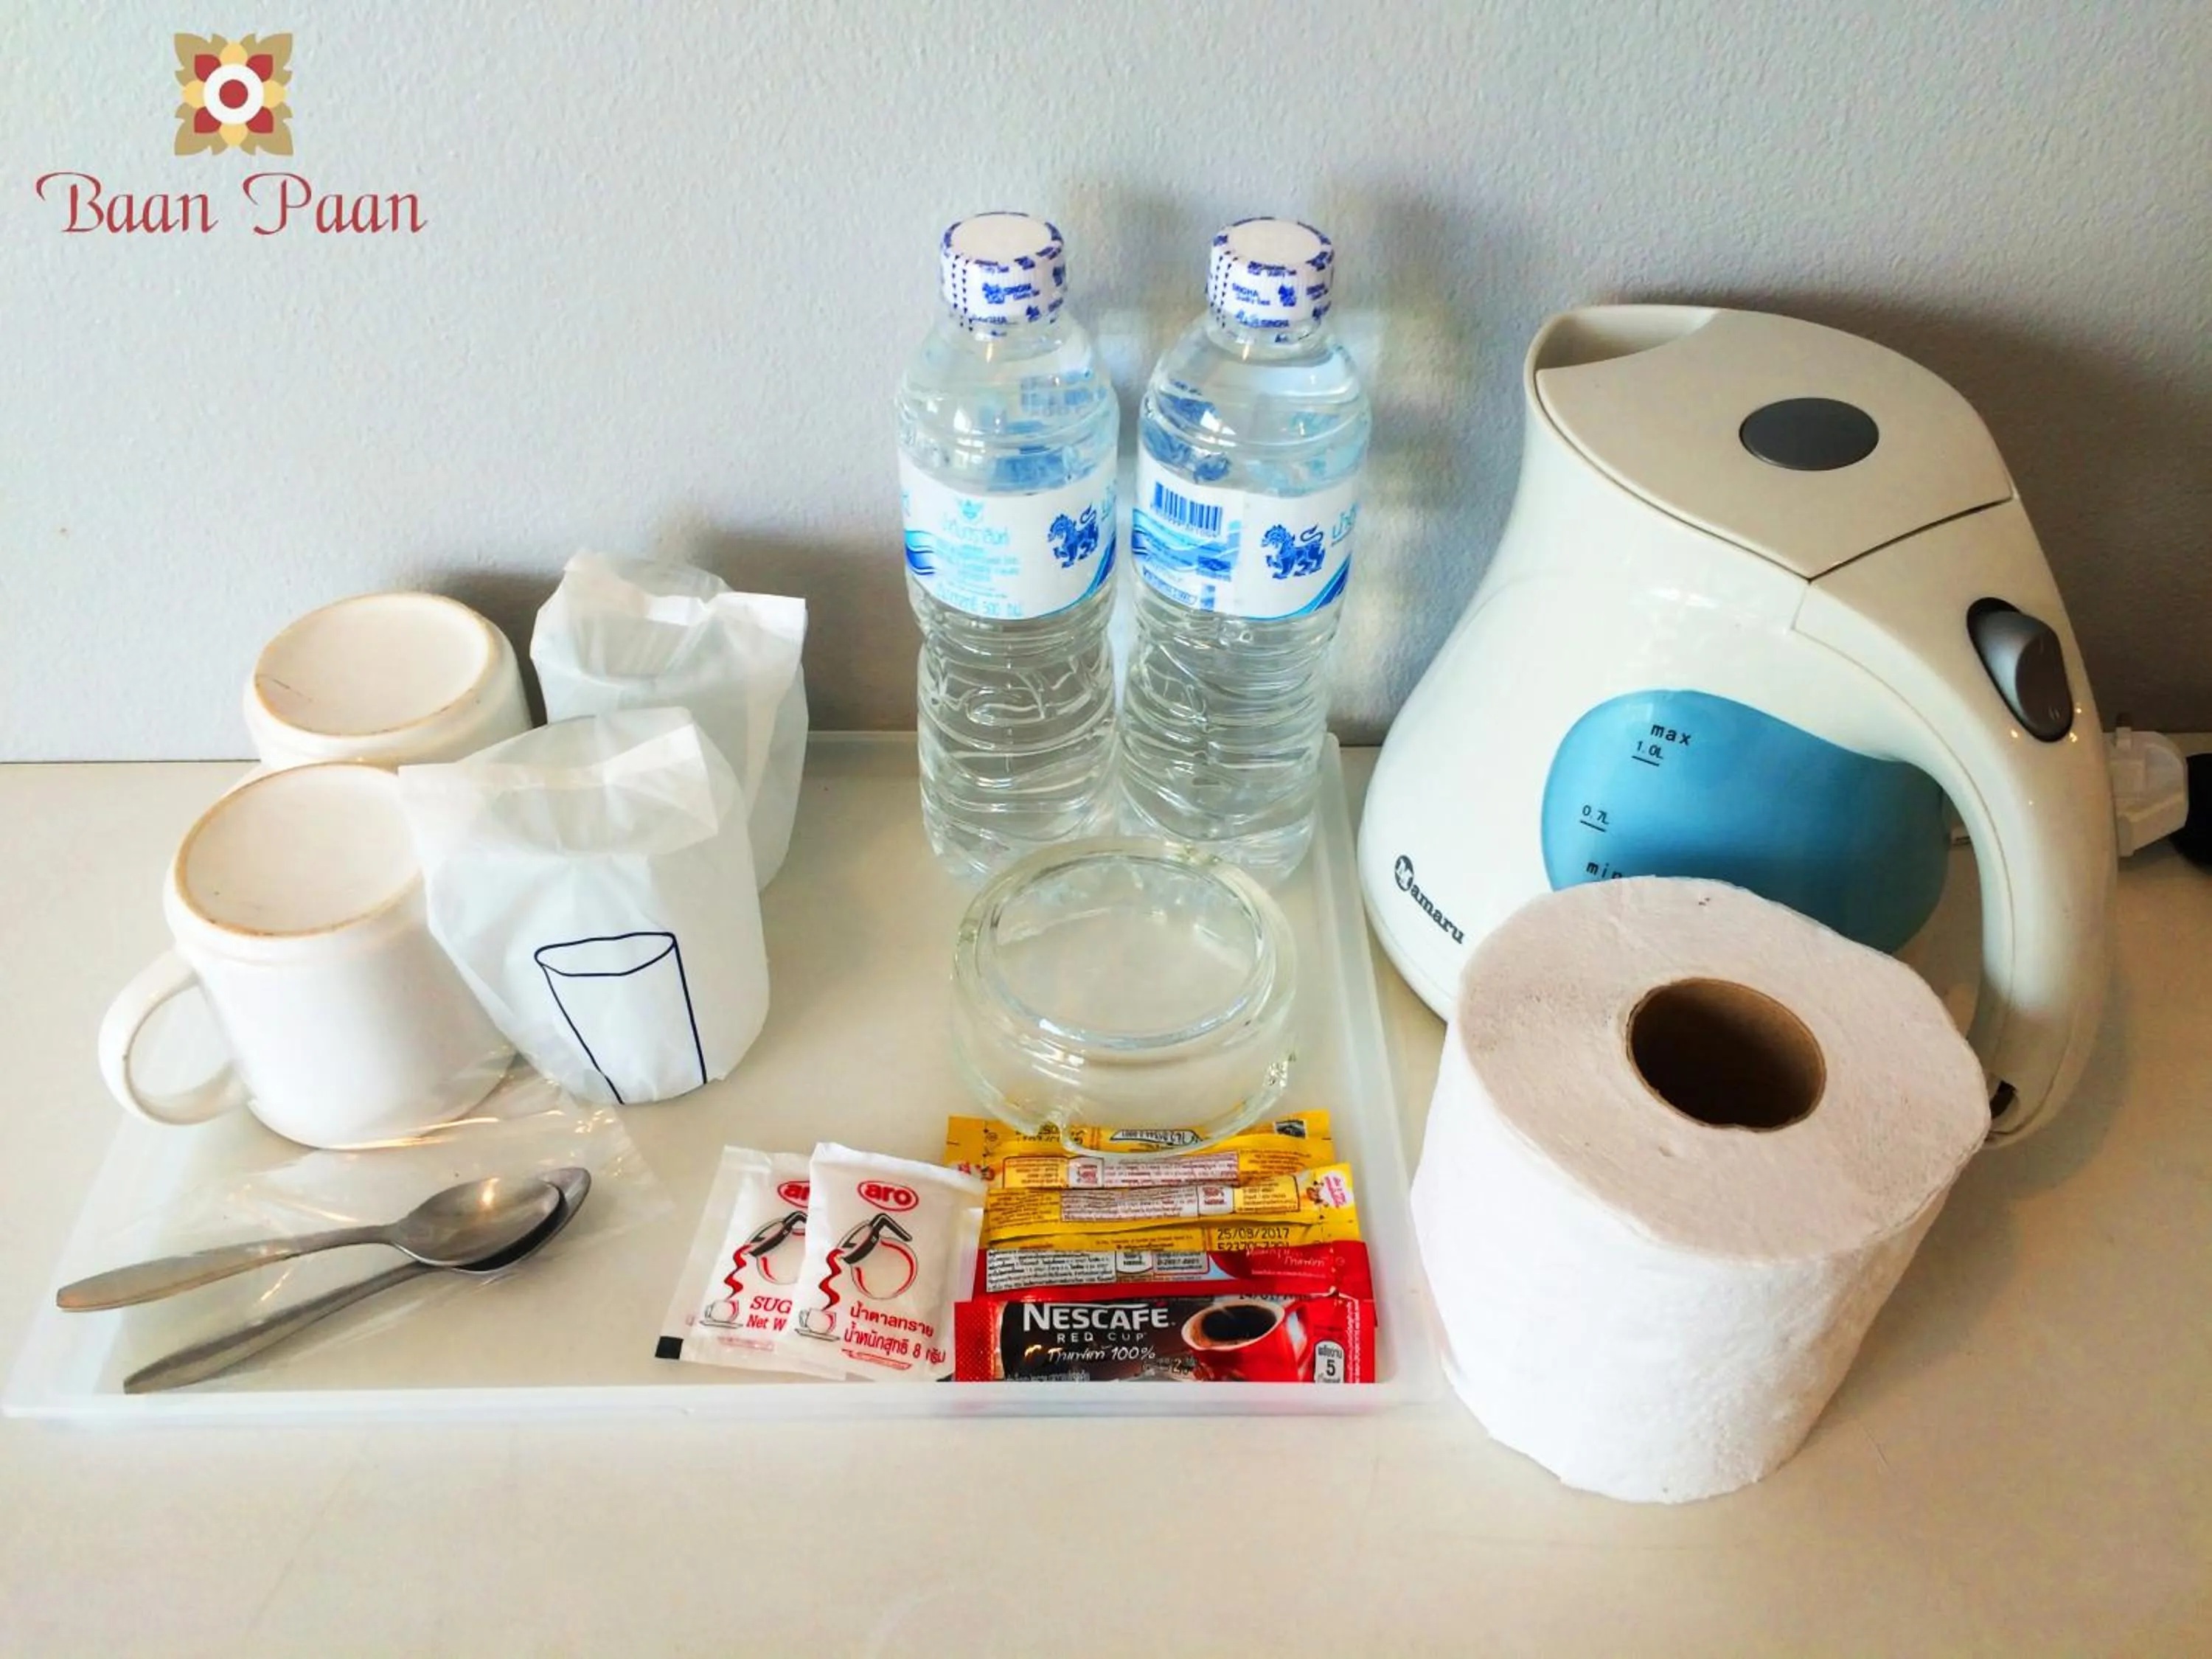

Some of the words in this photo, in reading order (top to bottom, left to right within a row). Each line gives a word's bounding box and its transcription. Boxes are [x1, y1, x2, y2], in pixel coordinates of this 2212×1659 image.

[1651, 723, 1691, 746] max
[864, 1183, 912, 1206] aro
[746, 1314, 769, 1329] Net
[849, 1300, 935, 1337] น้ำตาลทราย
[1057, 1332, 1093, 1343] RED
[1107, 1331, 1144, 1343] CUP
[912, 1343, 922, 1359] 8
[1111, 1344, 1156, 1360] 100%
[1325, 1359, 1336, 1377] 5
